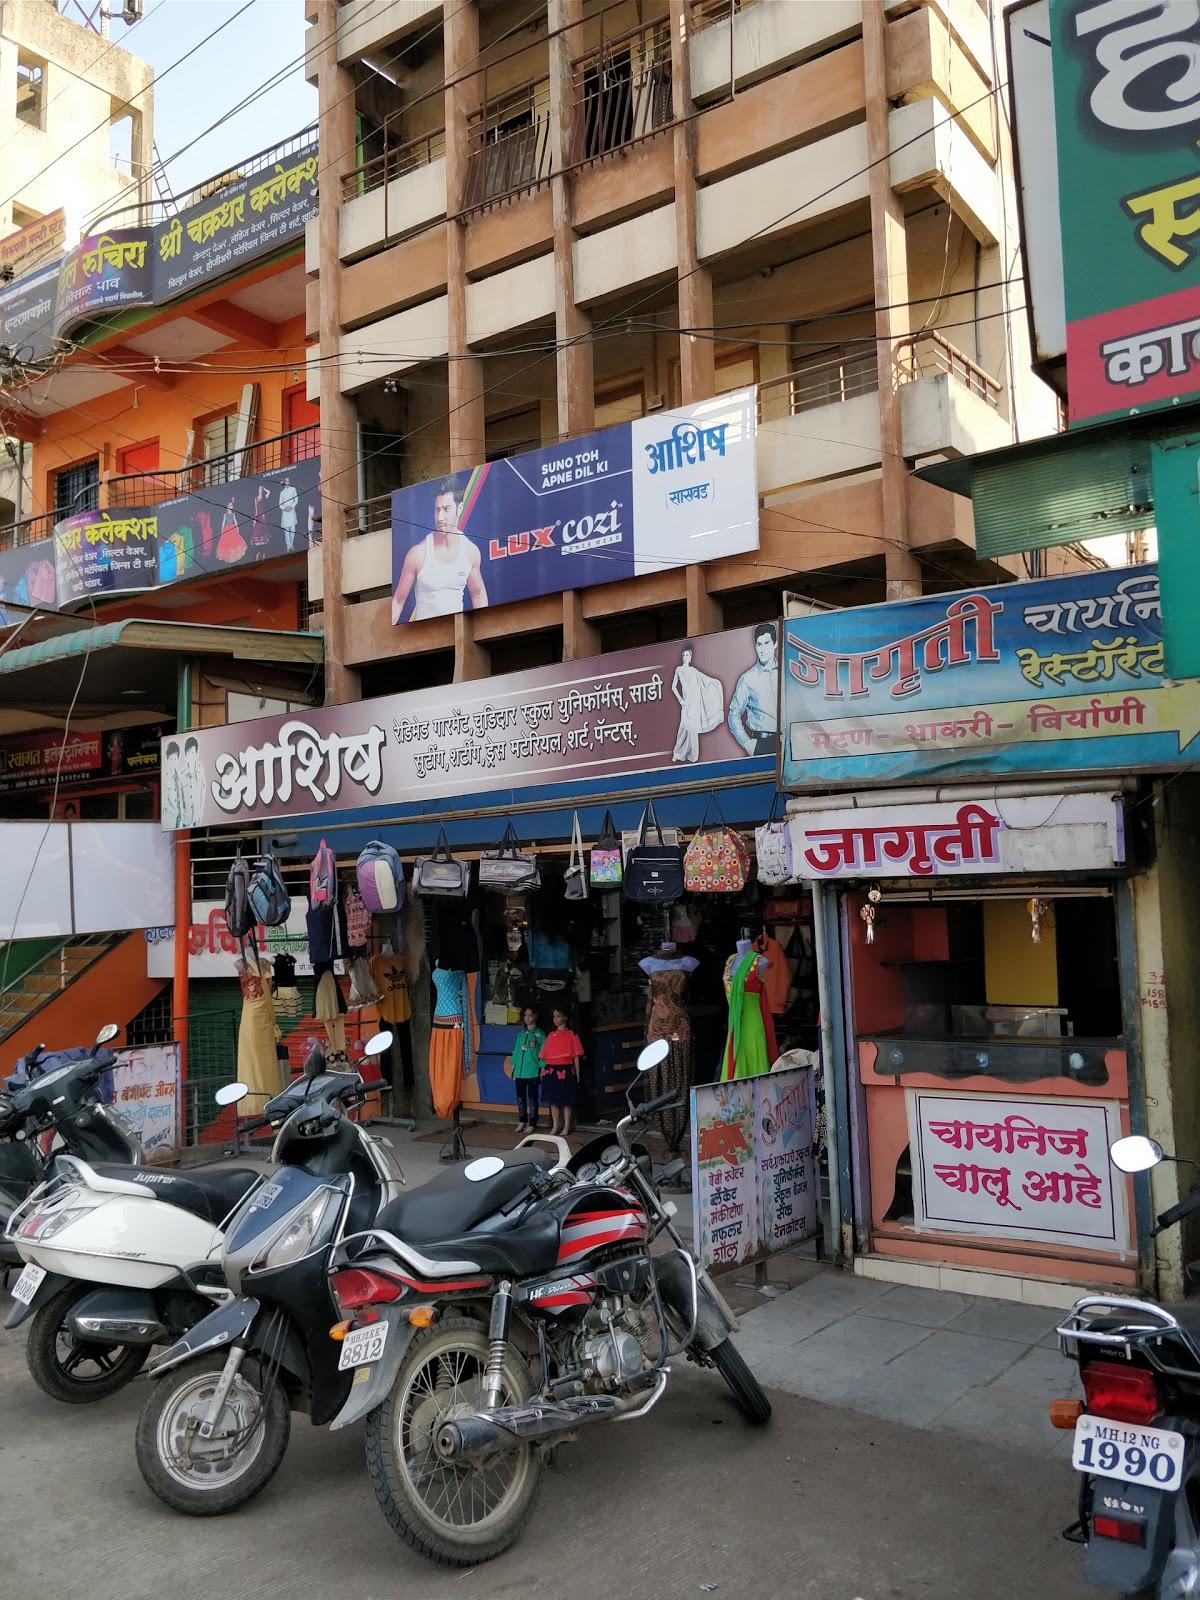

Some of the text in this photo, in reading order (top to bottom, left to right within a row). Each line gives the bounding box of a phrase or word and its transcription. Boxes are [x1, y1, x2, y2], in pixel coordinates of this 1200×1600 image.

[159, 218, 183, 262] श्री
[187, 193, 245, 244] चक्रधर
[81, 235, 148, 277] रुचिरा
[541, 449, 600, 476] SUNO TOH
[644, 422, 729, 475] आशिष
[541, 460, 608, 489] APNE DIL KI
[84, 512, 159, 547] कलेक्शन
[133, 558, 142, 569] टी
[787, 593, 1003, 697] जागृती
[393, 714, 430, 745] रेडिमेड
[212, 720, 386, 812] आशिष
[804, 804, 1002, 877] जागृती
[929, 1115, 1089, 1159] चायनिज
[132, 1172, 177, 1185] Jupiter
[933, 1163, 1102, 1211] चालू आहे
[711, 1221, 743, 1244] मफलर
[529, 1287, 545, 1301] HF
[341, 1337, 382, 1368] 8812
[1140, 1434, 1161, 1450] NG
[1078, 1437, 1176, 1483] 1990
